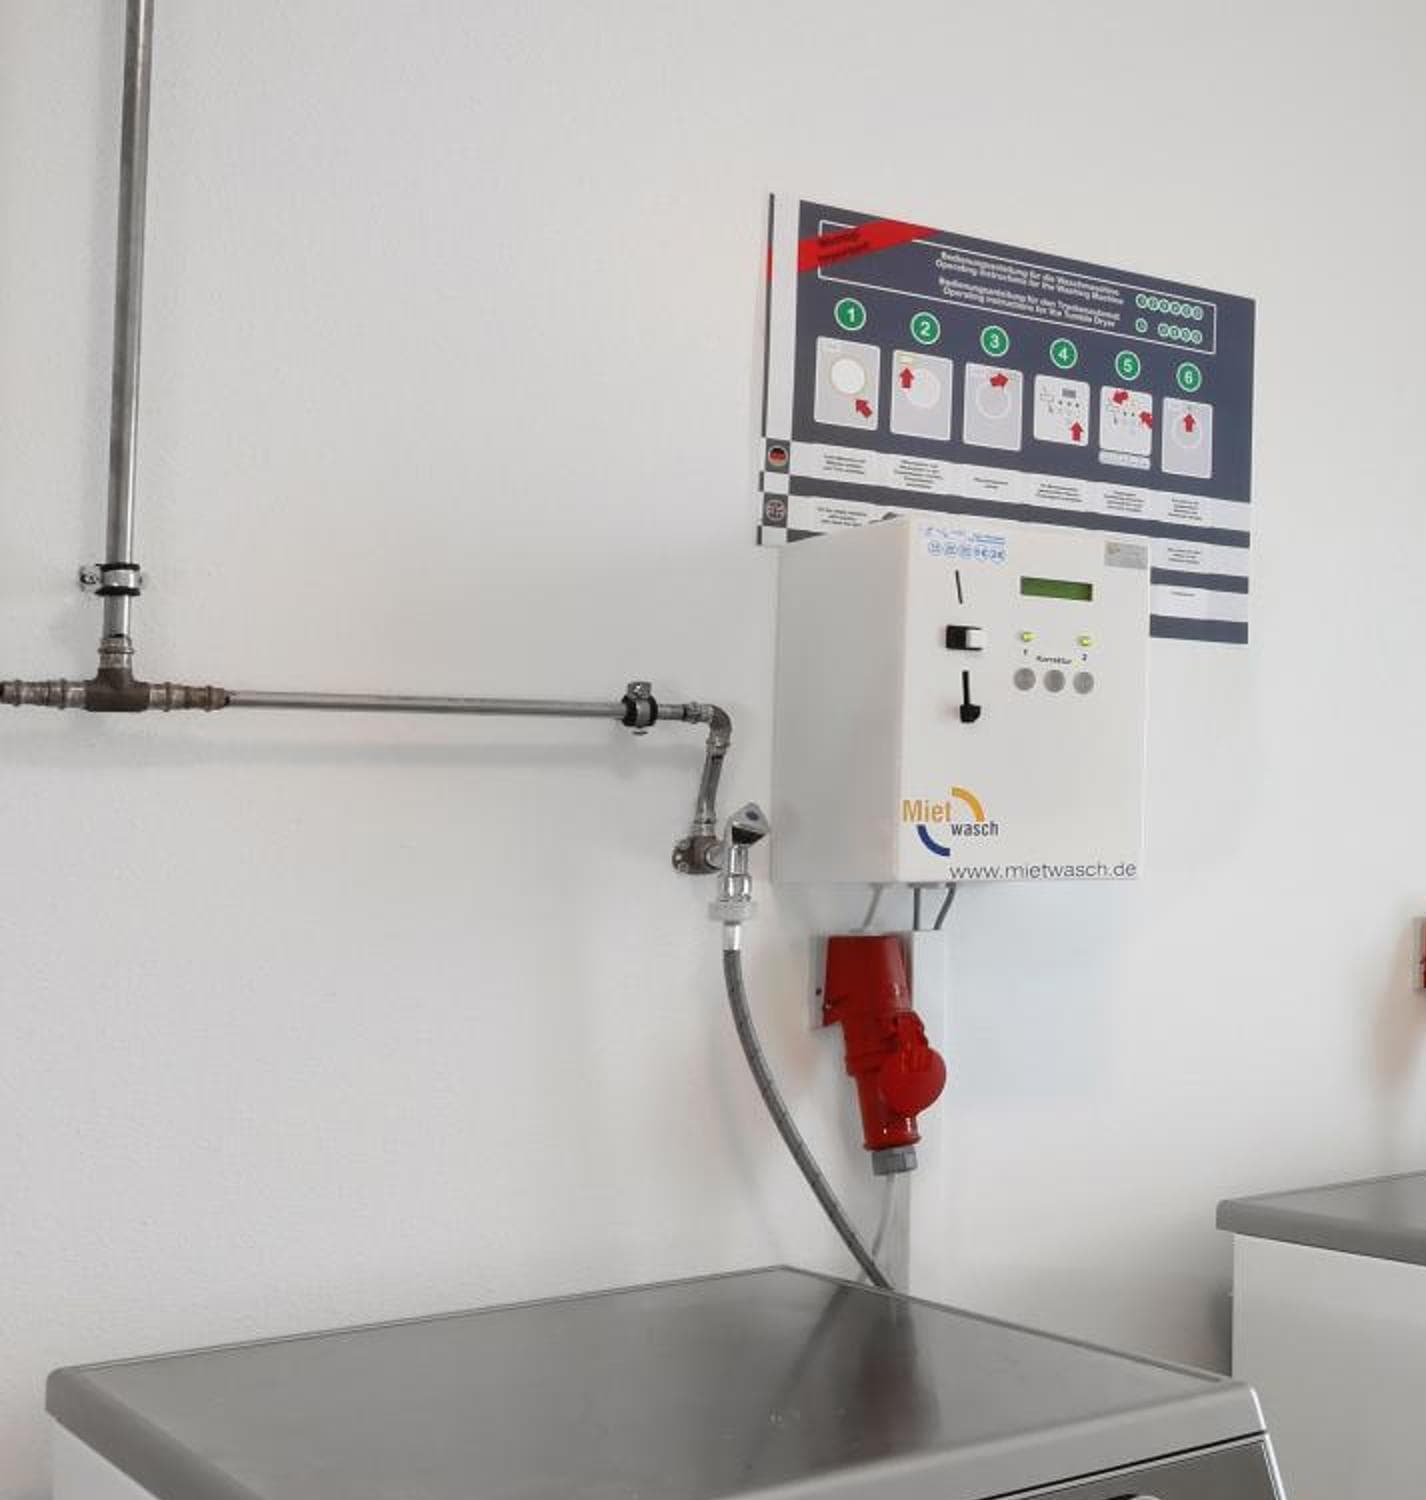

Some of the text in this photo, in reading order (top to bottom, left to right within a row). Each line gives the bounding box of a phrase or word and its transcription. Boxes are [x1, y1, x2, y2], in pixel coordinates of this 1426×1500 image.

[847, 307, 855, 323] 1
[920, 319, 930, 336] 2
[990, 331, 999, 348] 3
[1058, 344, 1069, 361] 4
[1123, 356, 1132, 373] 5
[1184, 368, 1193, 385] 6
[902, 799, 951, 822] Miet
[951, 821, 999, 836] wasch
[949, 863, 1137, 879] www.mietwasch.de
